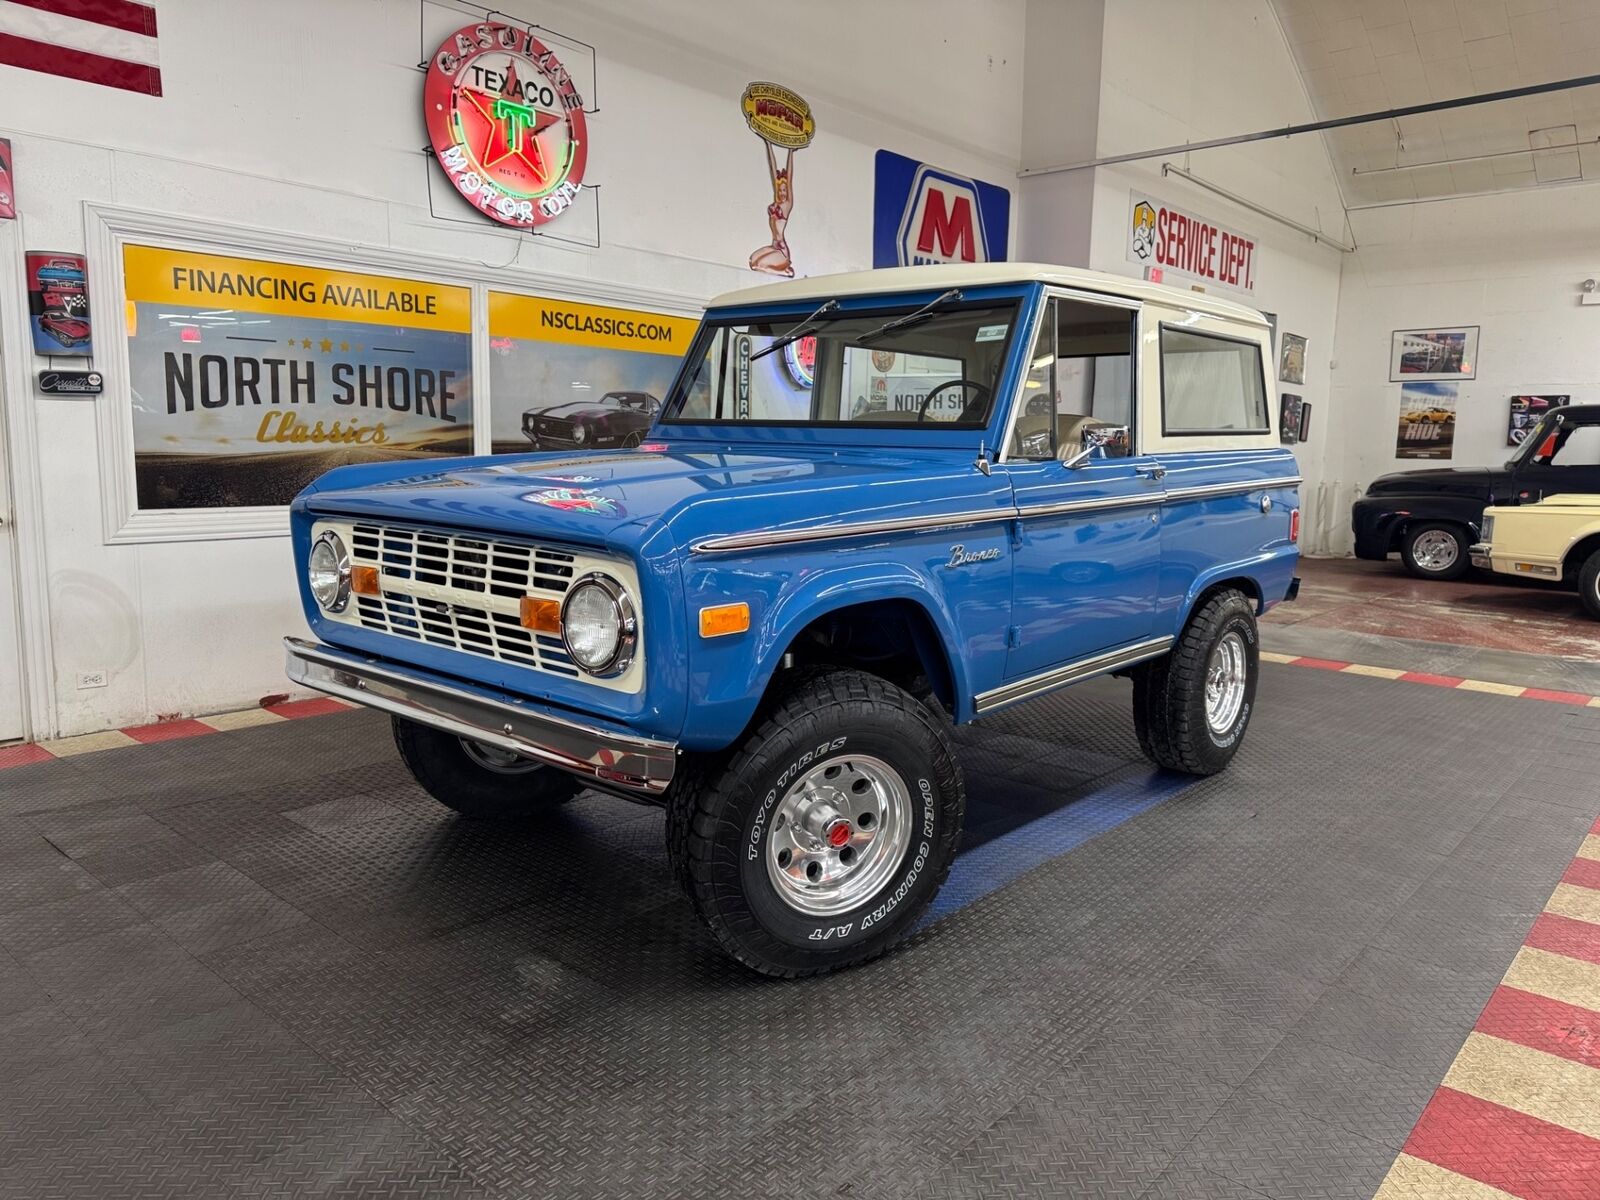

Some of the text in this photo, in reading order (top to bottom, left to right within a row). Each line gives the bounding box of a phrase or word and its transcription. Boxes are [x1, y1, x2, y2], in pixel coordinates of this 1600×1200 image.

[471, 66, 554, 107] TEXACO
[491, 99, 536, 152] T
[756, 99, 804, 132] MOPAR
[440, 144, 535, 224] MOTOR
[539, 181, 582, 217] OIL
[917, 189, 976, 263] M
[1156, 207, 1254, 290] SERVICE DEPT.
[172, 266, 437, 316] FINANCING AVAILABLE
[540, 309, 672, 344] NSCLASSICS.COM
[40, 373, 87, 390] Corvette
[164, 351, 457, 424] NORTH SHORE
[257, 410, 390, 445] Classics
[1404, 423, 1443, 440] RIDE
[944, 544, 1001, 569] Bronco
[748, 736, 848, 861] TOYO TIRES
[808, 778, 934, 941] OPEN COUNTRY A/T
